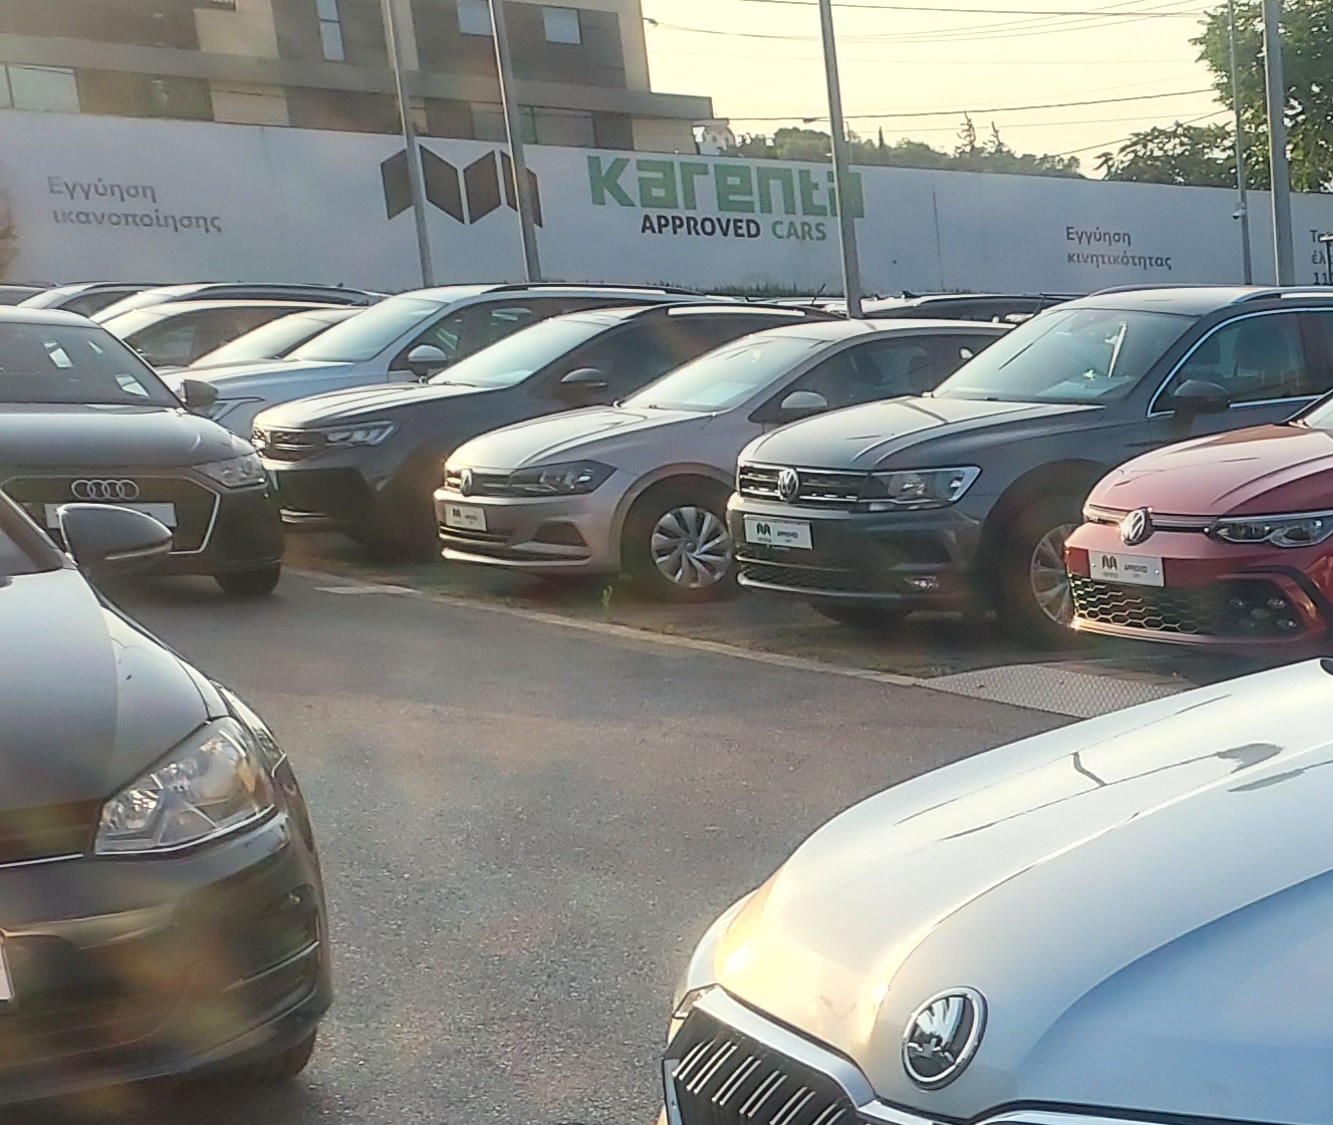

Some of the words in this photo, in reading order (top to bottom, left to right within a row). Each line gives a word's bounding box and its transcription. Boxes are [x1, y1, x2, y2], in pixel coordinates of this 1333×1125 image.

[47, 176, 157, 204] Εγγύηση
[52, 209, 223, 233] ικανοποίησης
[641, 214, 761, 238] APPROVED
[771, 220, 827, 241] CARS
[1065, 226, 1132, 247] Εγγύηση
[1067, 250, 1172, 271] κινητικότητας
